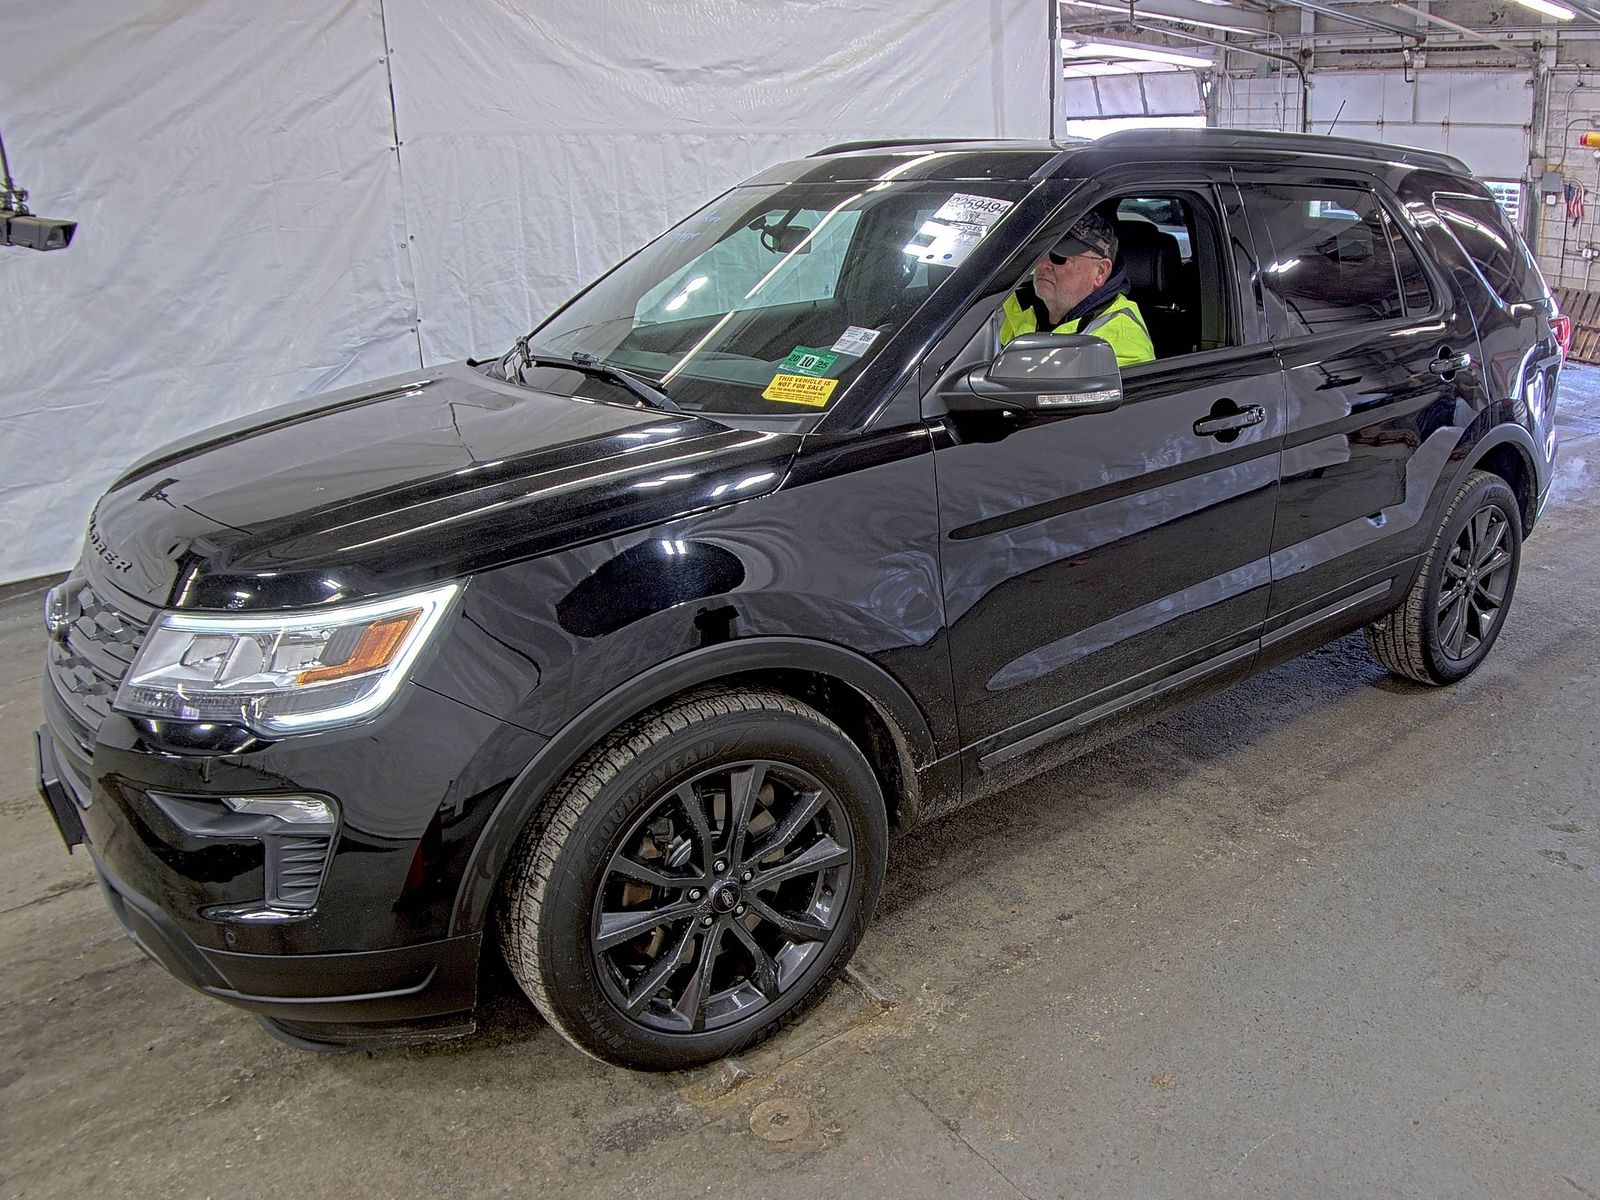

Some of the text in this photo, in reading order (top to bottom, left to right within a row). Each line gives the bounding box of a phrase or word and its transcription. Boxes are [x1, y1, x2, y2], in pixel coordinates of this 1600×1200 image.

[799, 356, 815, 367] 10
[815, 360, 829, 368] 25
[795, 377, 823, 385] VEHICLE
[807, 384, 825, 392] SALE
[587, 740, 714, 856] GOODYEAR
